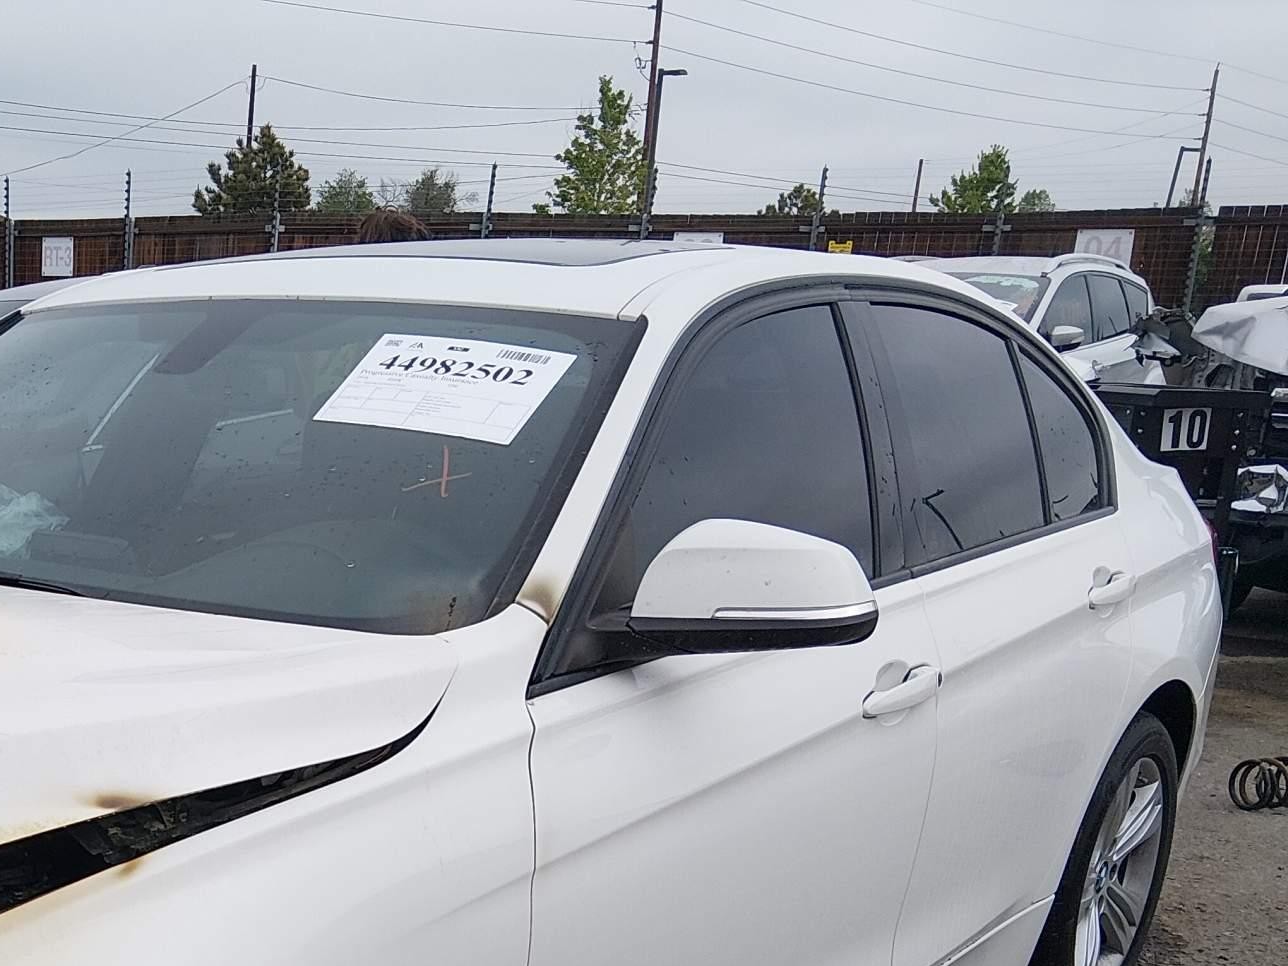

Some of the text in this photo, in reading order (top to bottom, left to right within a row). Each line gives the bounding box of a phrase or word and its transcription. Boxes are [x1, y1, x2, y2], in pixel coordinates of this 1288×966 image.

[44, 246, 72, 267] RT-3
[379, 354, 533, 386] 44982502
[1168, 409, 1208, 449] 10
